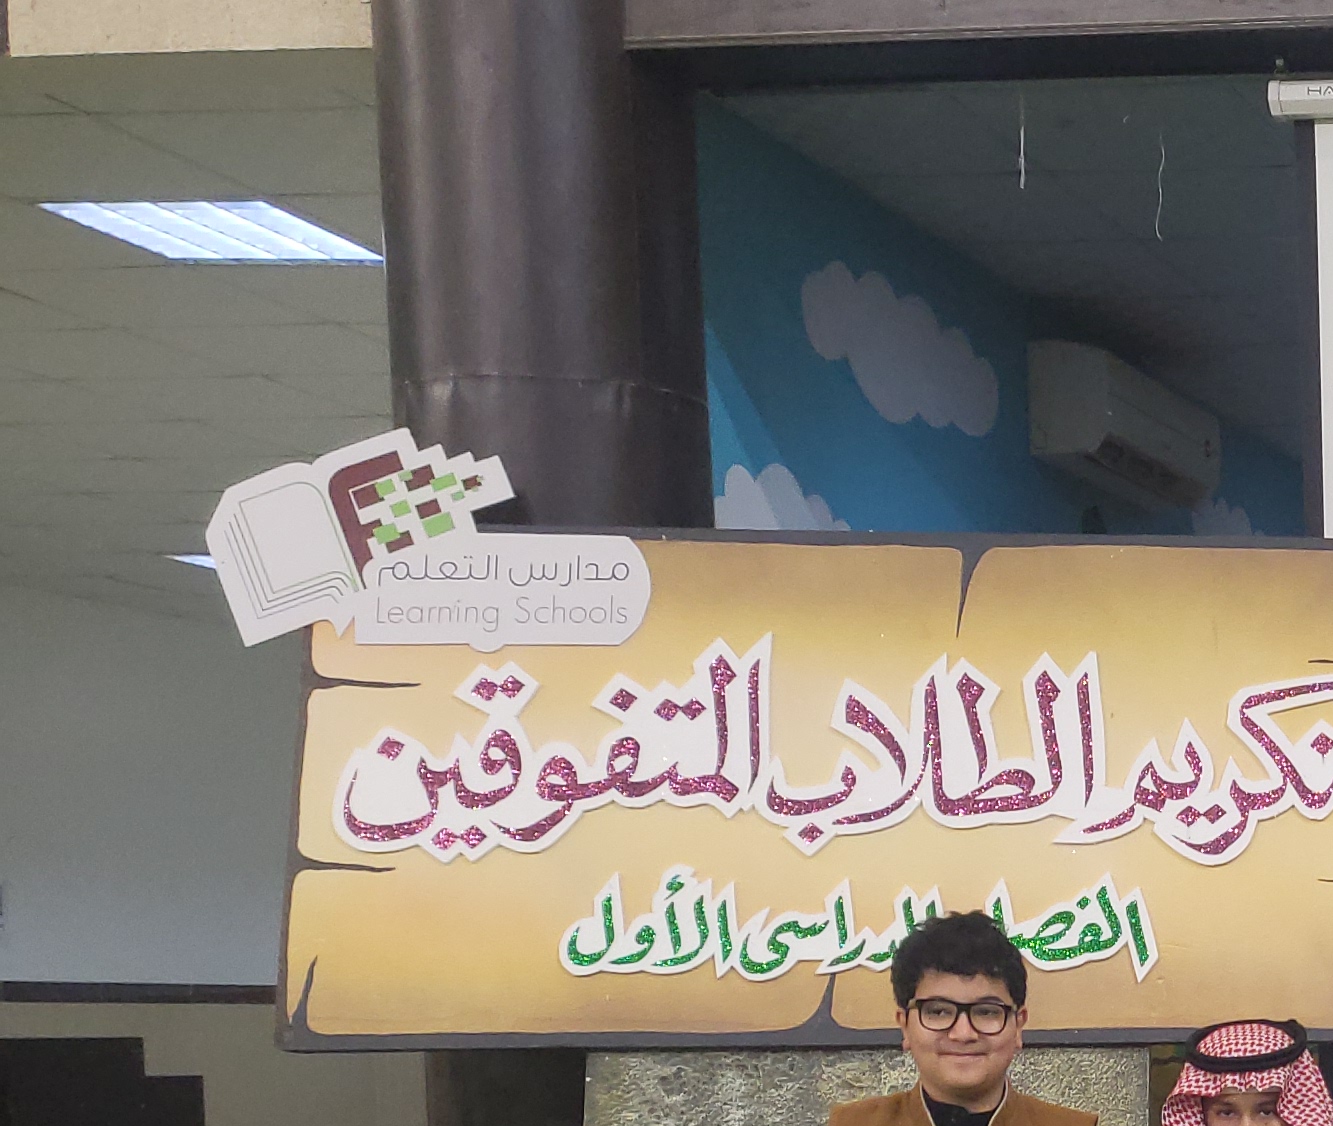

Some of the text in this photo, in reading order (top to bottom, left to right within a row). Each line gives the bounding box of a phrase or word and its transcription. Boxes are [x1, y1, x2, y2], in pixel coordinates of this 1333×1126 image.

[375, 594, 629, 633] Learning Schools
[377, 553, 630, 587] مدارس التعلم
[343, 653, 761, 851] المتفوقين
[766, 668, 1095, 845] الطلاب
[567, 874, 733, 967] الأول
